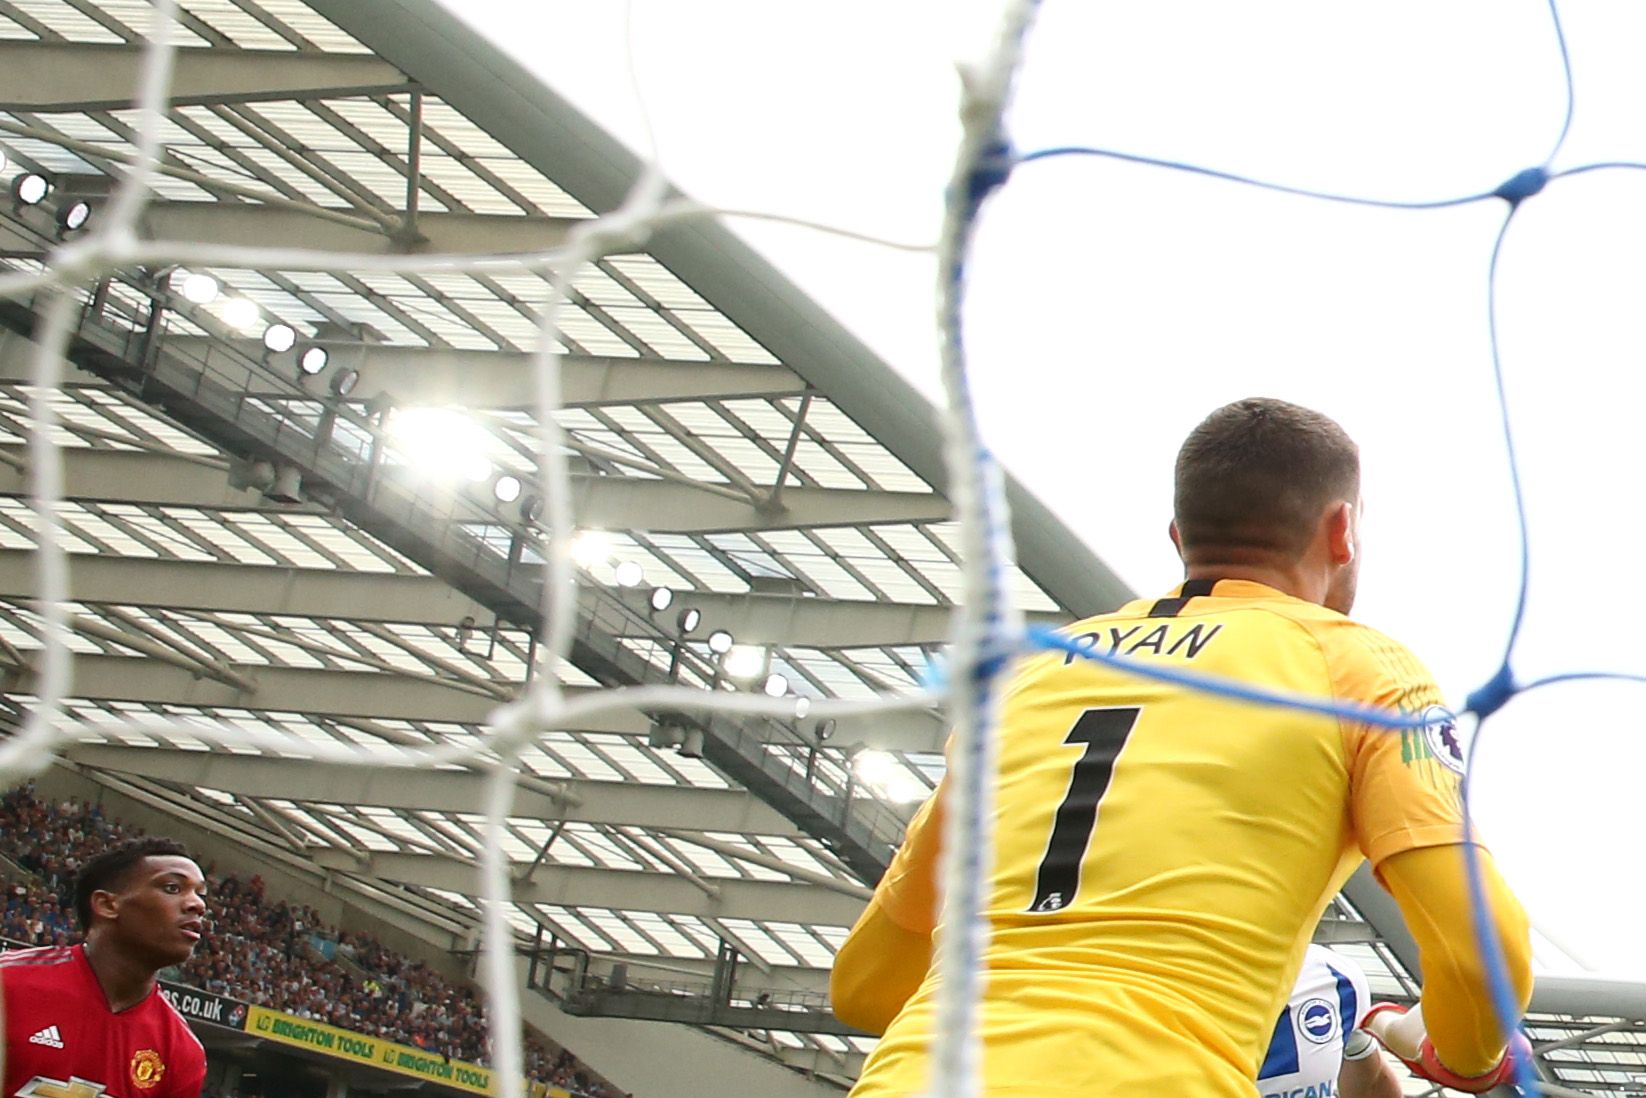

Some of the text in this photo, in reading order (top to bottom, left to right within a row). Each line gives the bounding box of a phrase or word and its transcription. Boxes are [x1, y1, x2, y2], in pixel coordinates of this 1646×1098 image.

[1063, 623, 1224, 665] RYAN
[1026, 706, 1143, 915] 1
[272, 1017, 335, 1049] BRIGHTON
[337, 1036, 375, 1059] TOOLS
[397, 1051, 454, 1081] BRIGHTON
[455, 1065, 490, 1088] TOOLS
